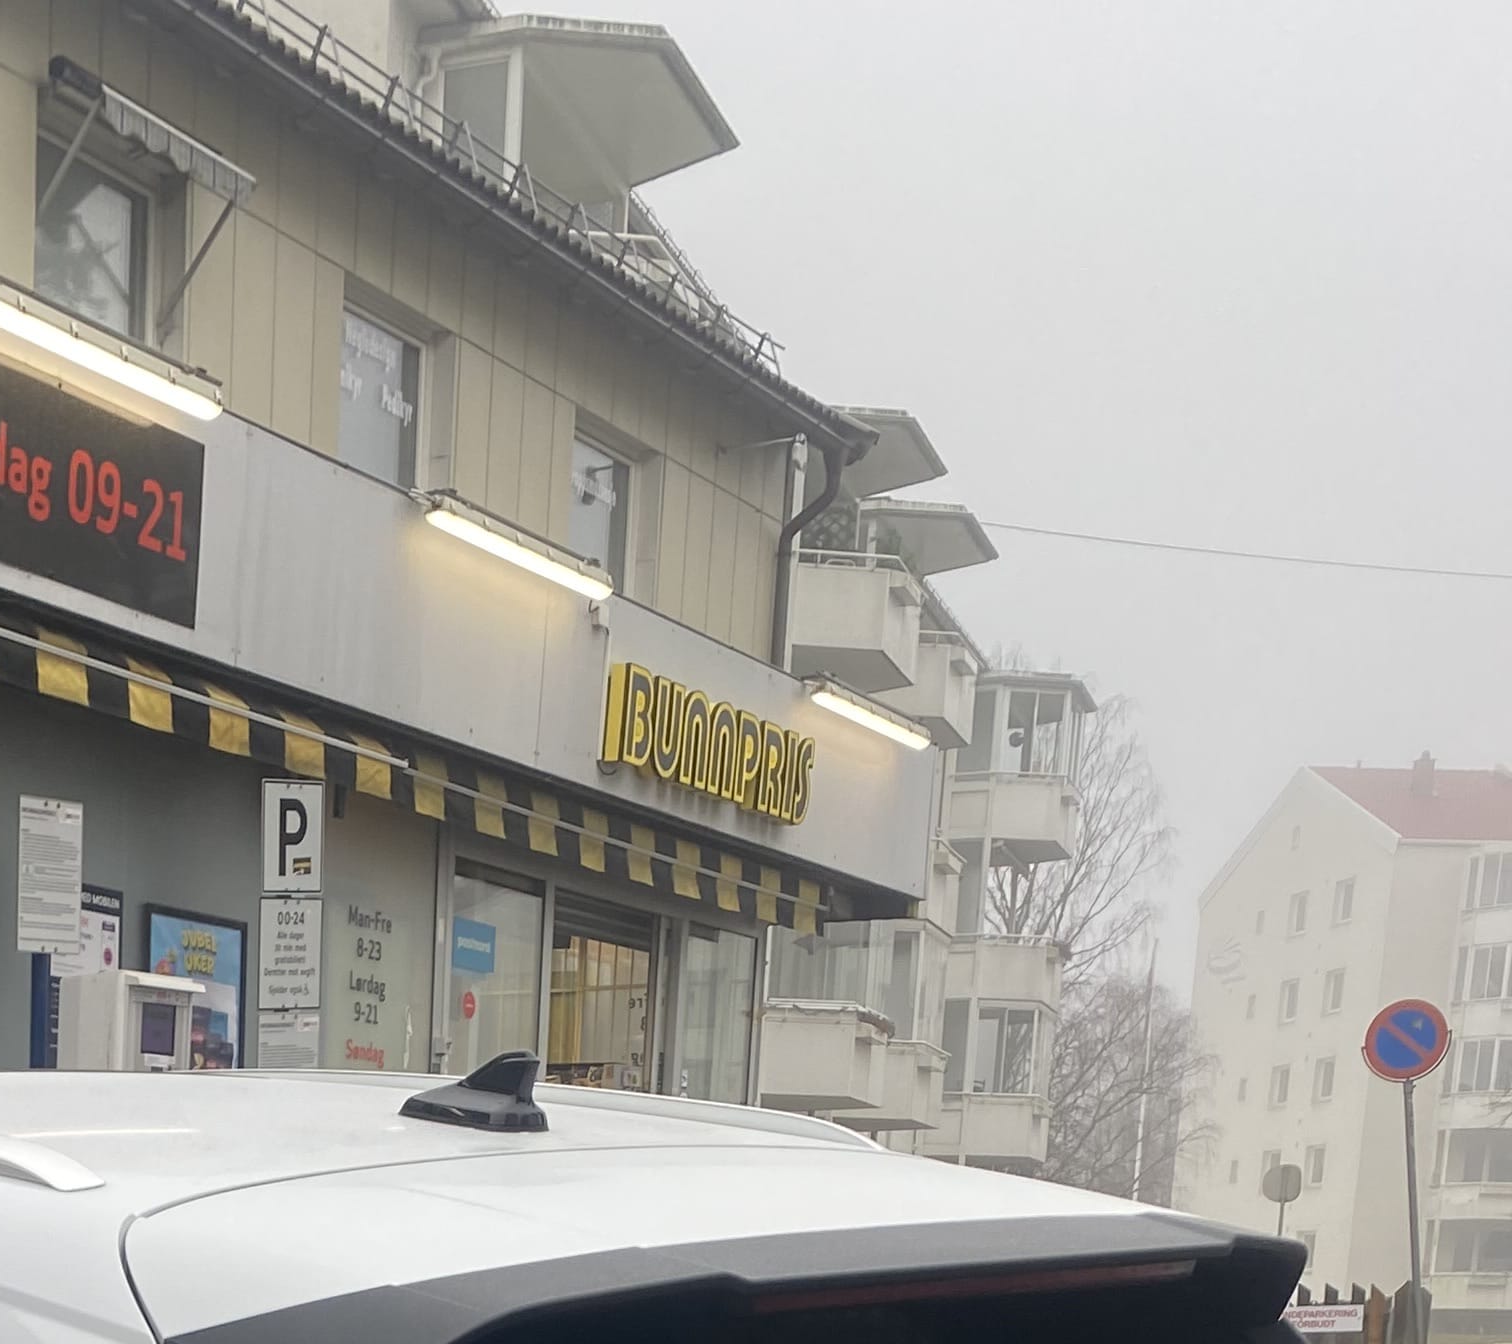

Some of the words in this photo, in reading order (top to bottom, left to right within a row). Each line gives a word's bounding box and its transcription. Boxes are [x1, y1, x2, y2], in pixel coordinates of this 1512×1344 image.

[67, 449, 186, 562] 09-21
[604, 662, 815, 826] BUNNPRIS
[278, 797, 308, 877] P
[276, 911, 306, 926] 00-24
[348, 904, 393, 934] Man-Fre
[180, 929, 218, 956] JUBEL
[355, 937, 383, 962] 8-23
[183, 953, 217, 978] UKER
[349, 970, 387, 1002] Lørdag
[353, 1004, 379, 1026] 9-21
[345, 1038, 386, 1069] Søndag
[1294, 1319, 1336, 1329] ORBUDT
